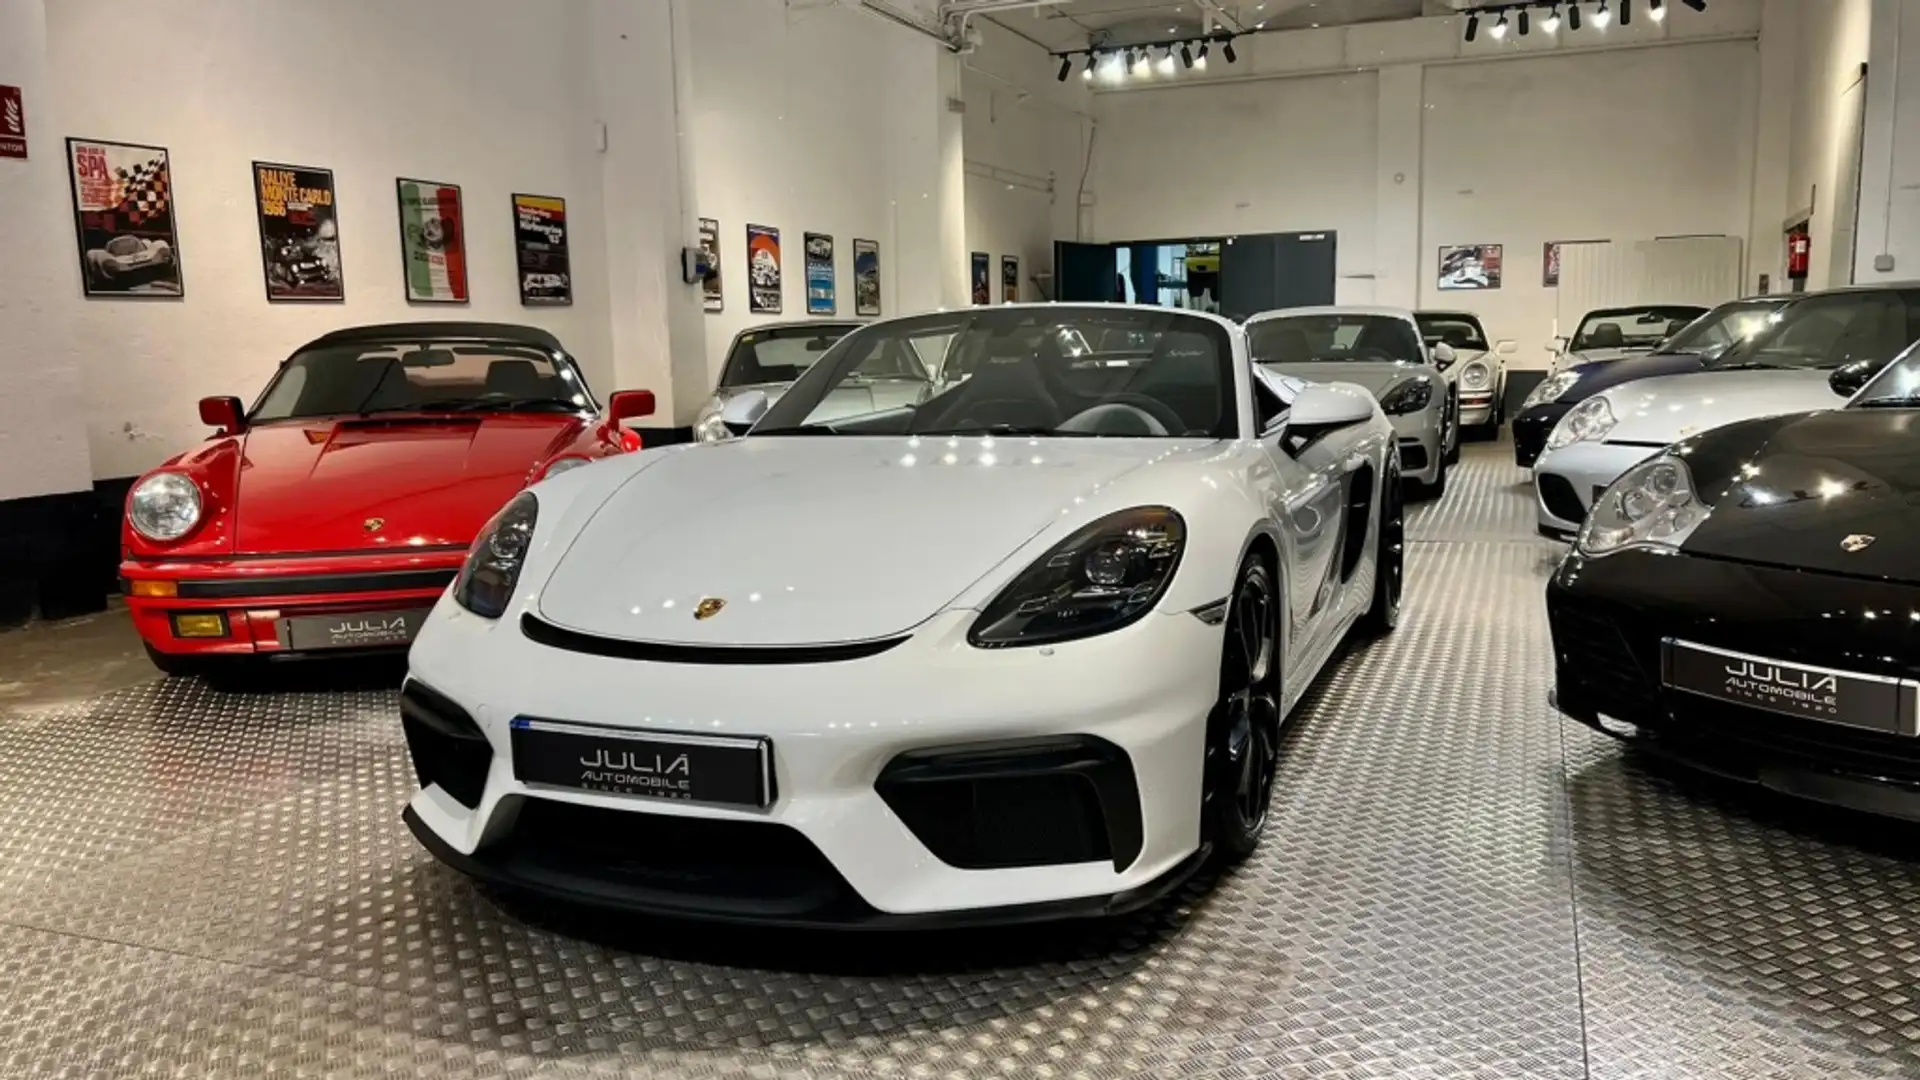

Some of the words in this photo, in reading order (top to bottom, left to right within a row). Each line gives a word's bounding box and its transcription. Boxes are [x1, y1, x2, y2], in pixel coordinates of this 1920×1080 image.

[77, 153, 109, 179] SPA
[260, 168, 296, 187] RALLYE
[261, 185, 298, 203] MONTE
[300, 188, 331, 206] CARLO
[1725, 677, 1837, 705] AUTOMOBILE
[581, 770, 689, 790] AUTOMOBILE
